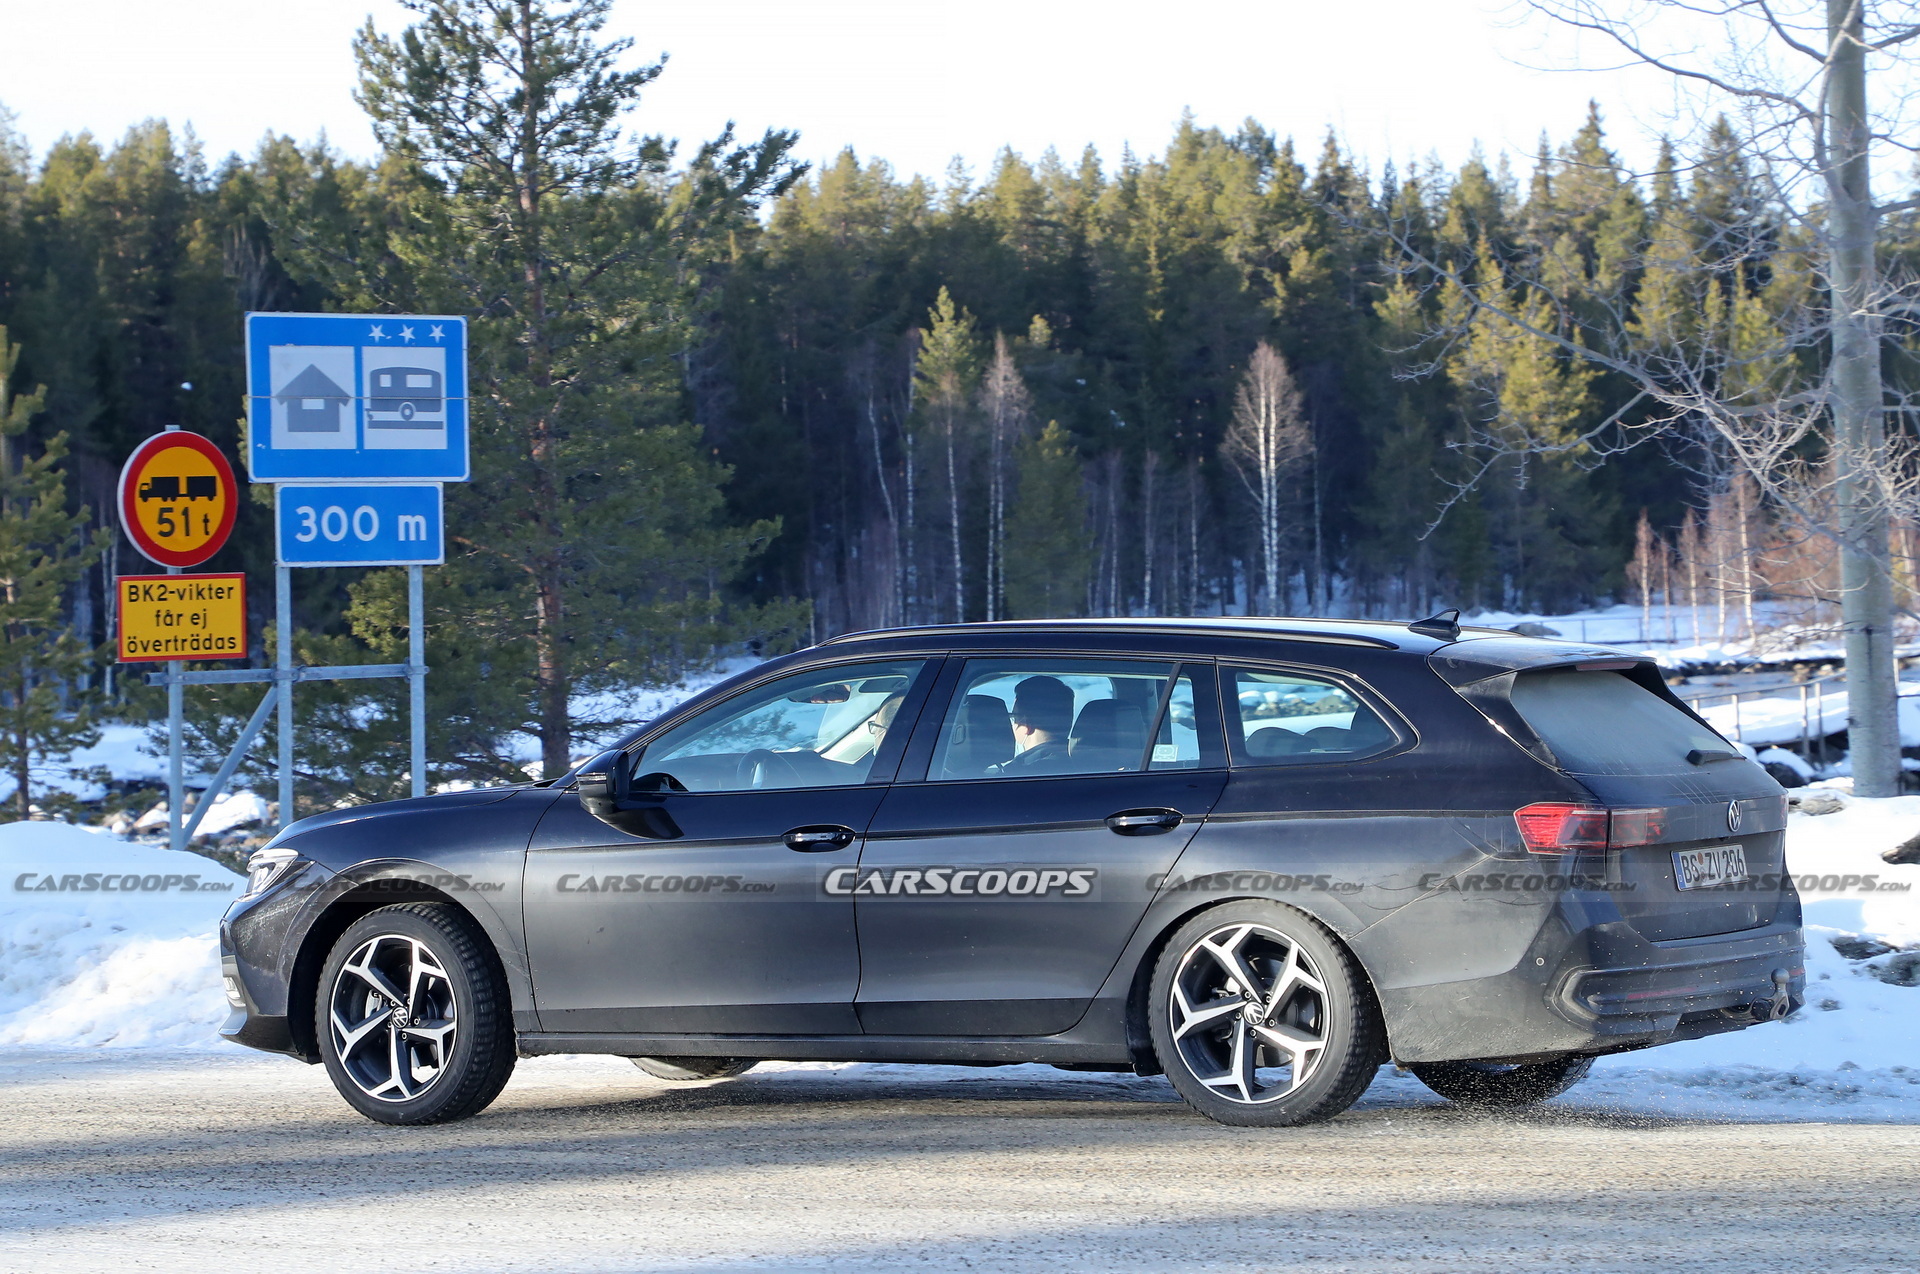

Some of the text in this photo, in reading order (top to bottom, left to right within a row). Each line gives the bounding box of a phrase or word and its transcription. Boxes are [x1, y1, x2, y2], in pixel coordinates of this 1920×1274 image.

[157, 507, 210, 537] 51 t
[295, 505, 427, 543] 300 m
[128, 583, 234, 602] BK2-vikter
[155, 608, 207, 629] får ej
[127, 633, 237, 653] överträdas
[1681, 855, 1700, 883] BS
[1705, 852, 1722, 880] ZV
[1722, 849, 1745, 877] 206
